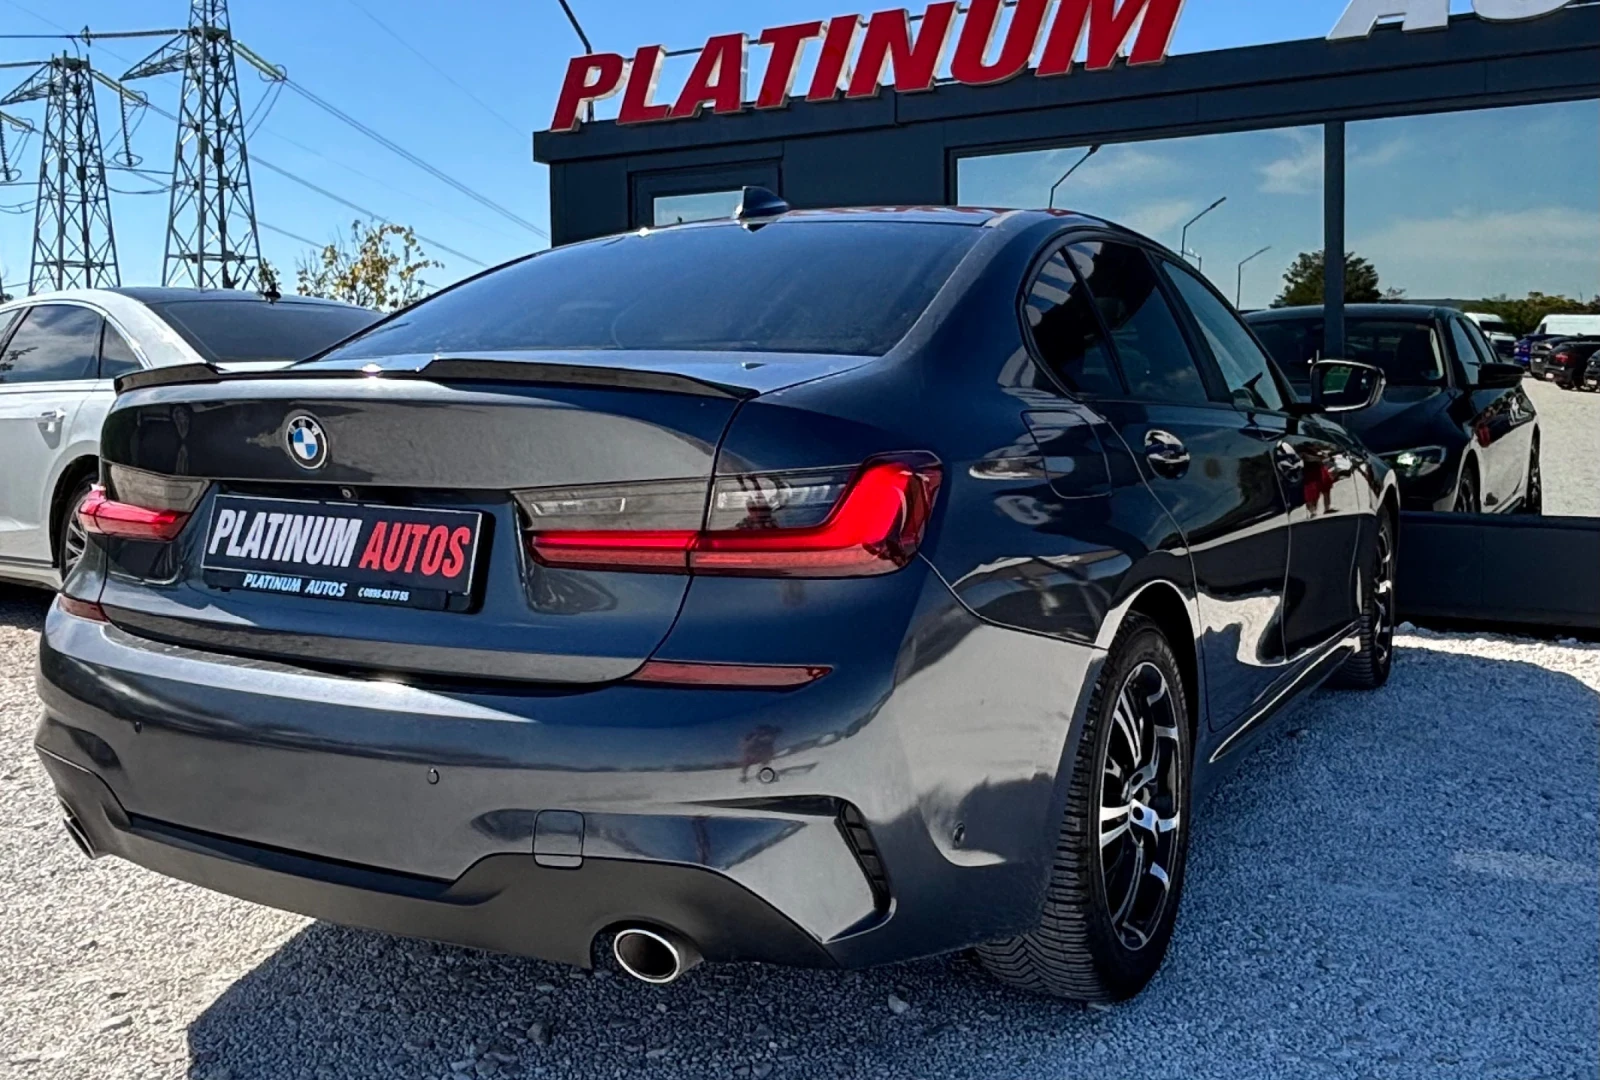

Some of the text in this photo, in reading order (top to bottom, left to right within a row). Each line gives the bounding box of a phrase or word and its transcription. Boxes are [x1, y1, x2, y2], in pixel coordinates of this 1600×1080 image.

[549, 0, 1184, 133] PLATINUM
[208, 509, 471, 578] PLATINUM AUTOS
[242, 573, 302, 593] PLATINUM
[304, 579, 348, 597] AUTOS
